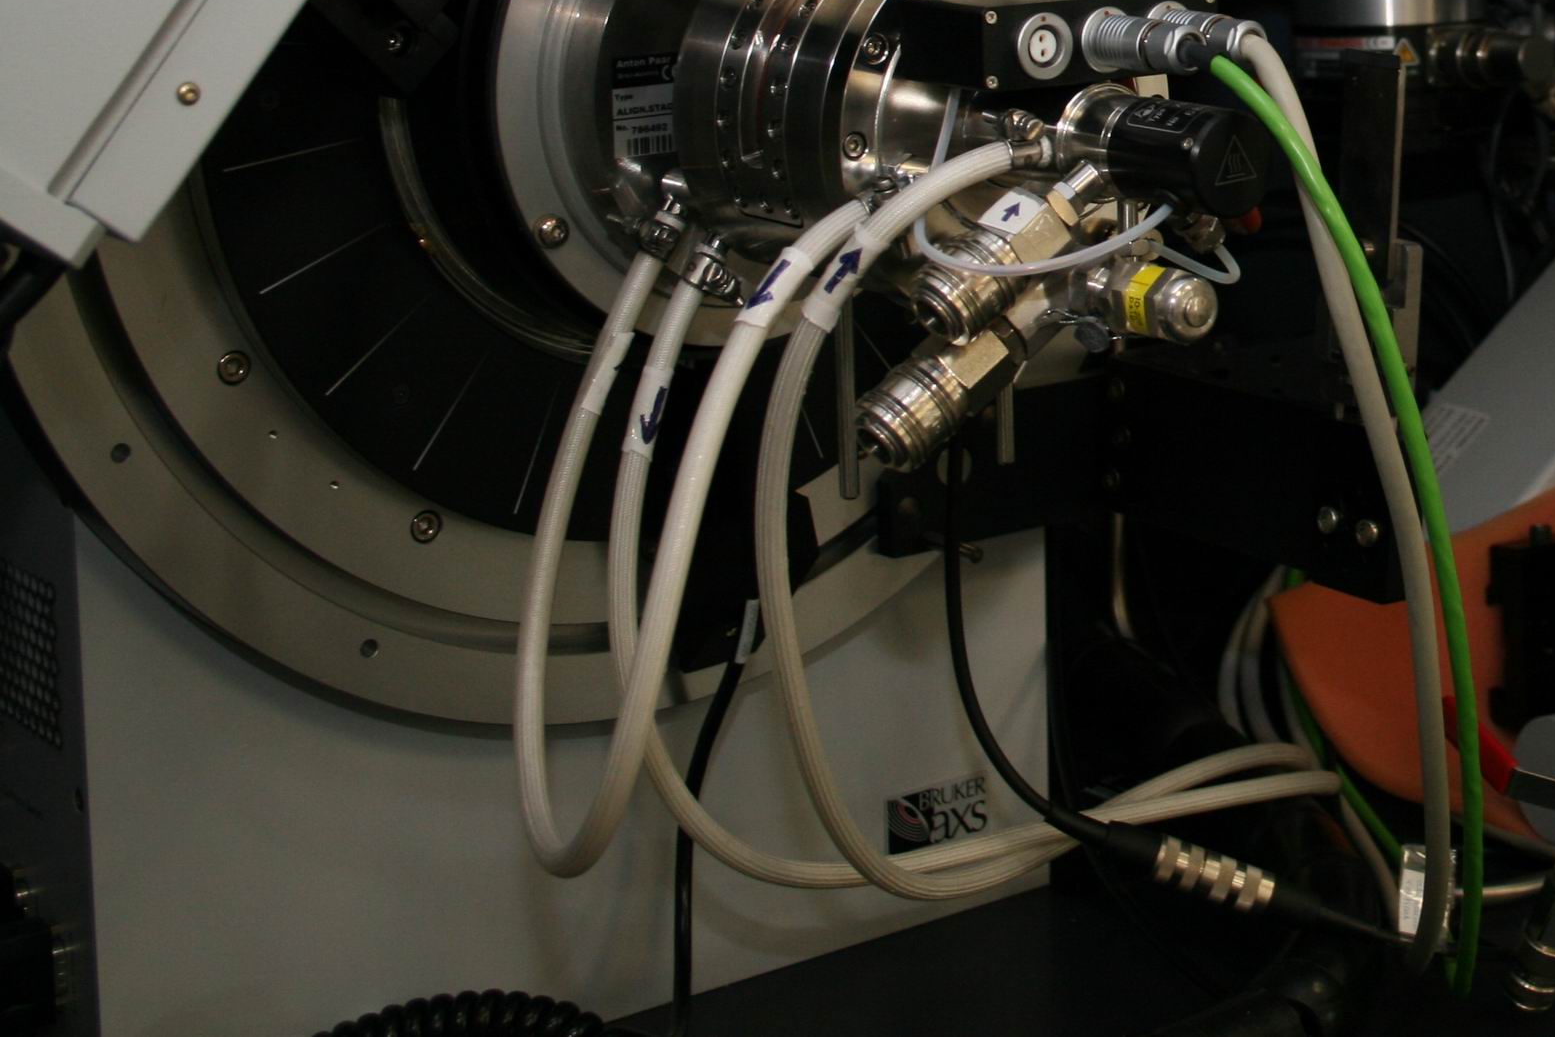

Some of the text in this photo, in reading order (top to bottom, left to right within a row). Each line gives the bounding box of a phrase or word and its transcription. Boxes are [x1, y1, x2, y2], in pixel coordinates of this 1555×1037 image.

[616, 56, 672, 69] Anton Paar
[919, 777, 986, 811] BRUKER
